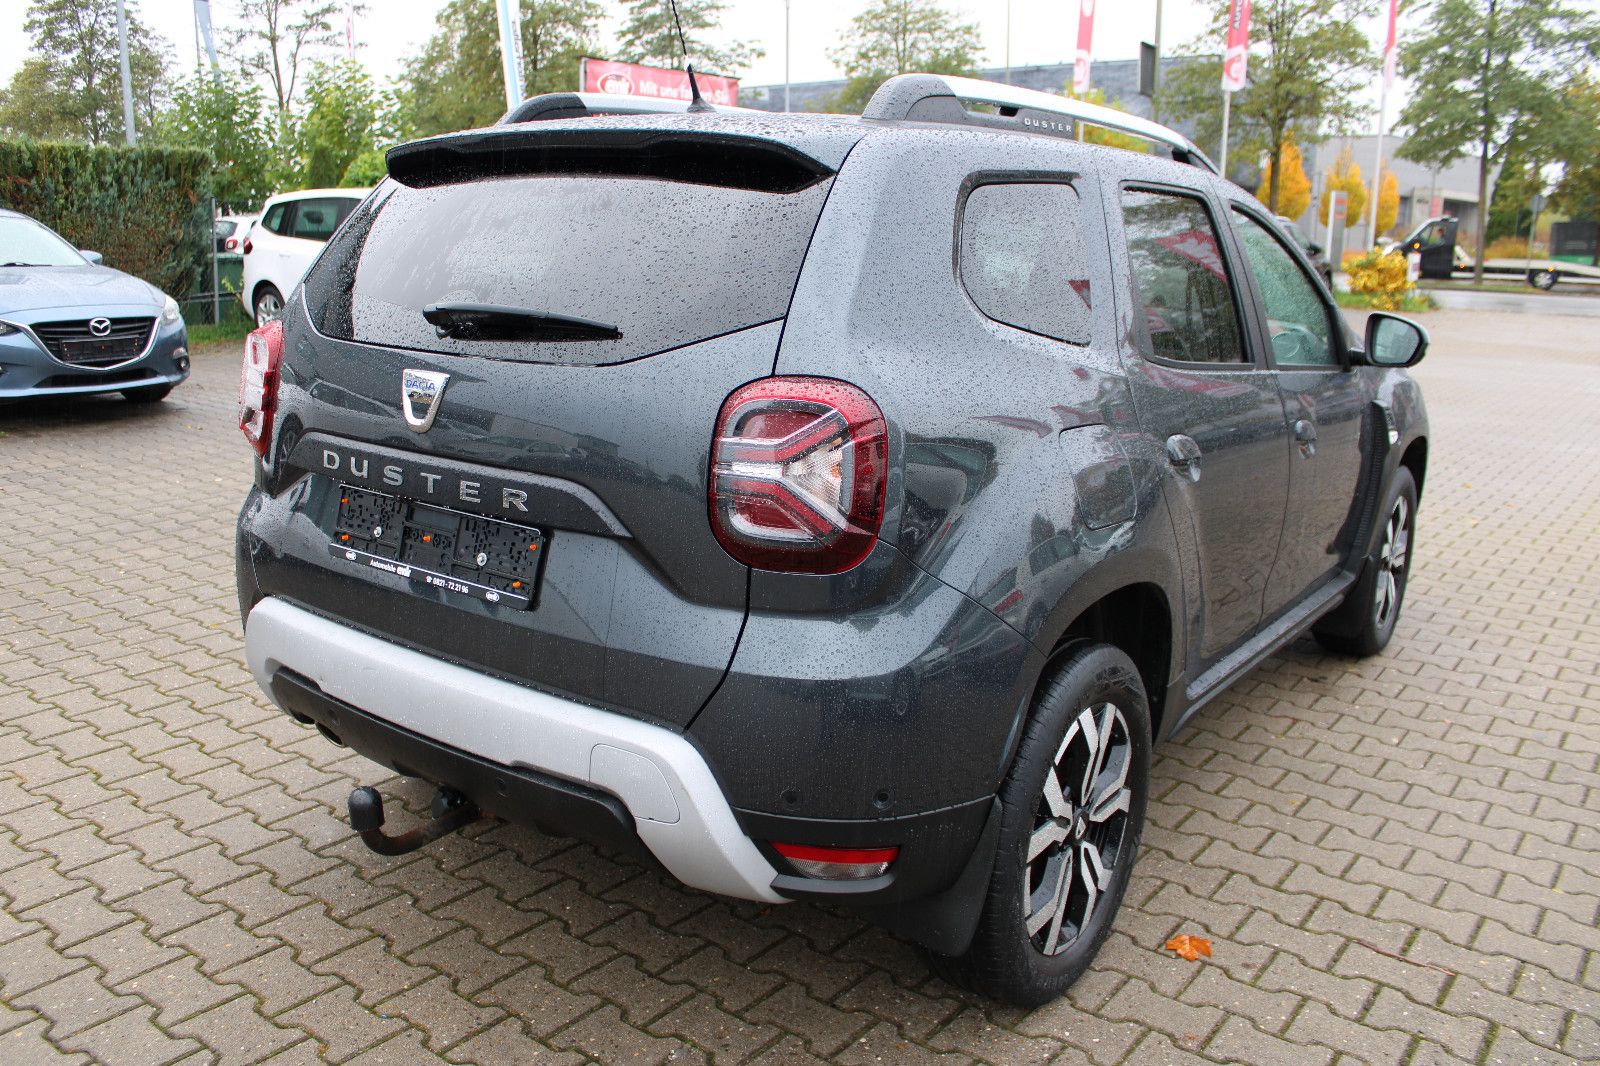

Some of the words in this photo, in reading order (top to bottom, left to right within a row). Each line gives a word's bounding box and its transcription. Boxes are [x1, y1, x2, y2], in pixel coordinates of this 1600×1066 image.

[639, 80, 657, 96] Mit
[1024, 117, 1072, 132] DUSTER
[406, 379, 436, 391] DACIA
[322, 449, 529, 512] DUSTER
[370, 559, 396, 573] Automobile
